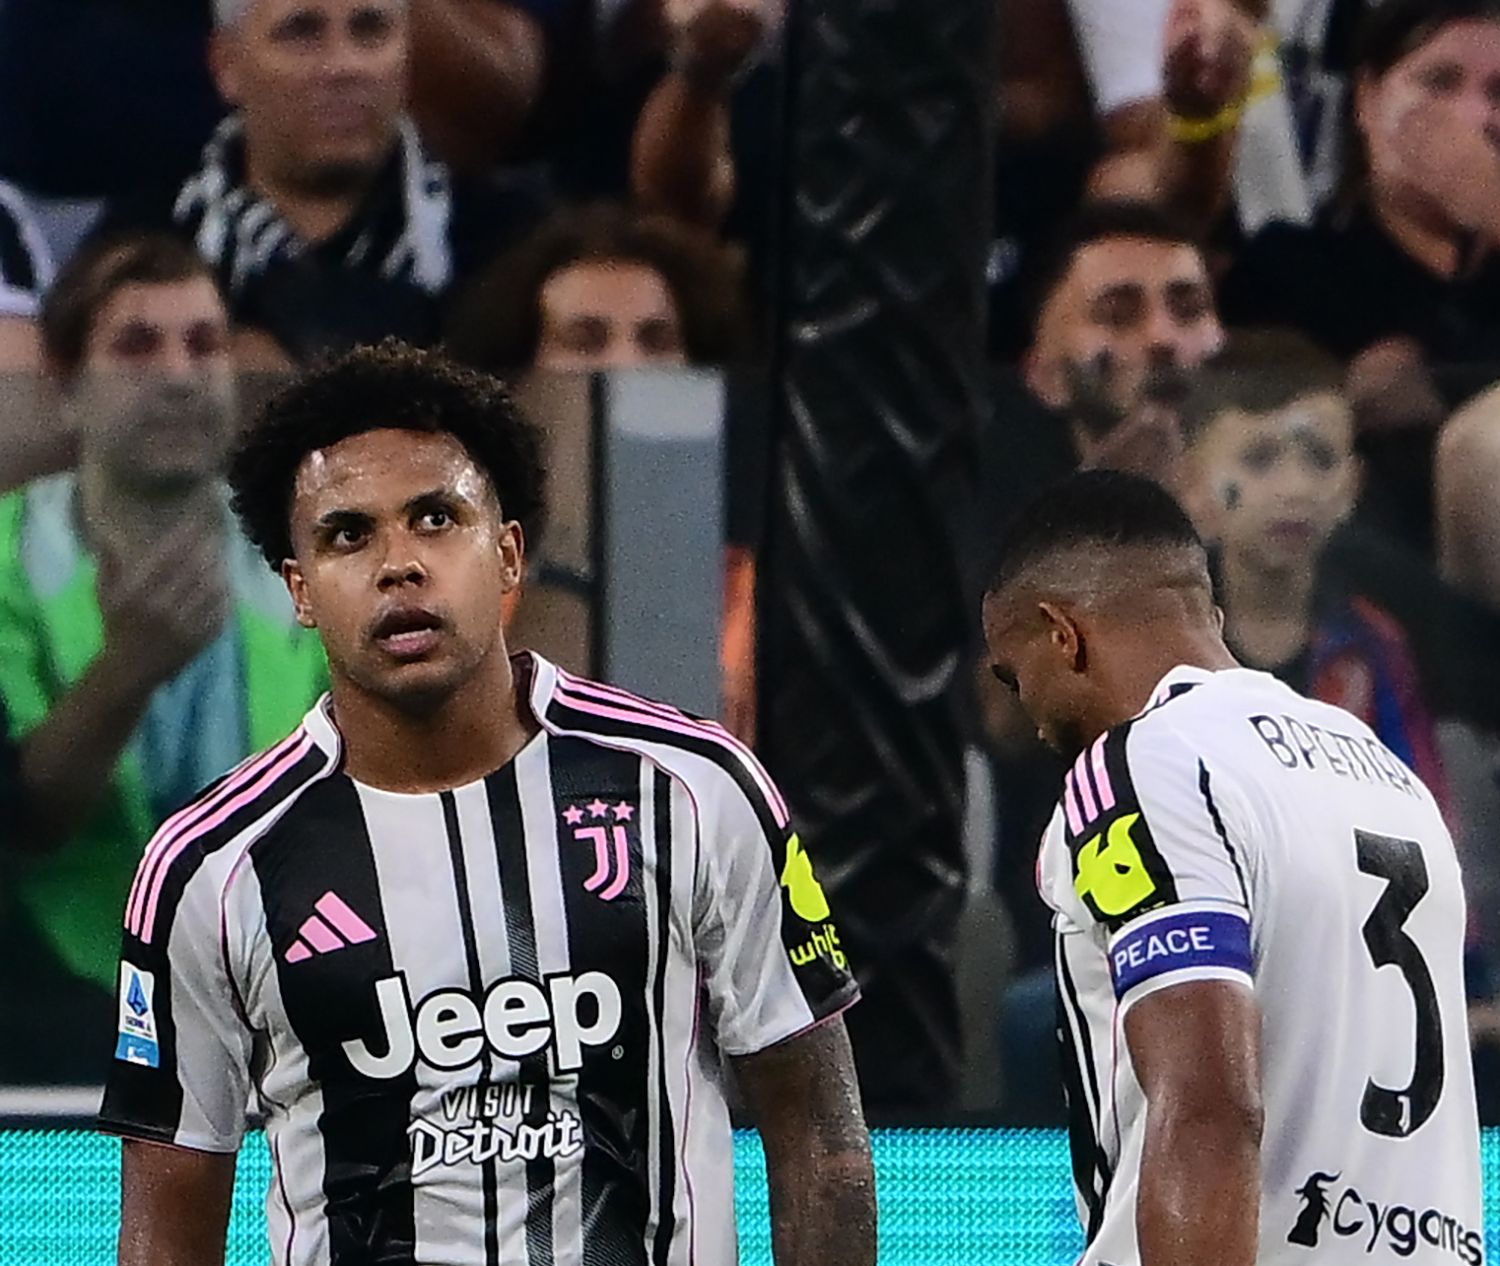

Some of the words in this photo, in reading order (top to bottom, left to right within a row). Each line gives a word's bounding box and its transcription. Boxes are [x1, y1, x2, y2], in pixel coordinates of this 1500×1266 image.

[1113, 925, 1215, 978] PEACE
[1352, 826, 1446, 1138] 3
[340, 970, 622, 1080] Jeep
[441, 1085, 535, 1122] VISIT
[406, 1109, 583, 1185] Detroit
